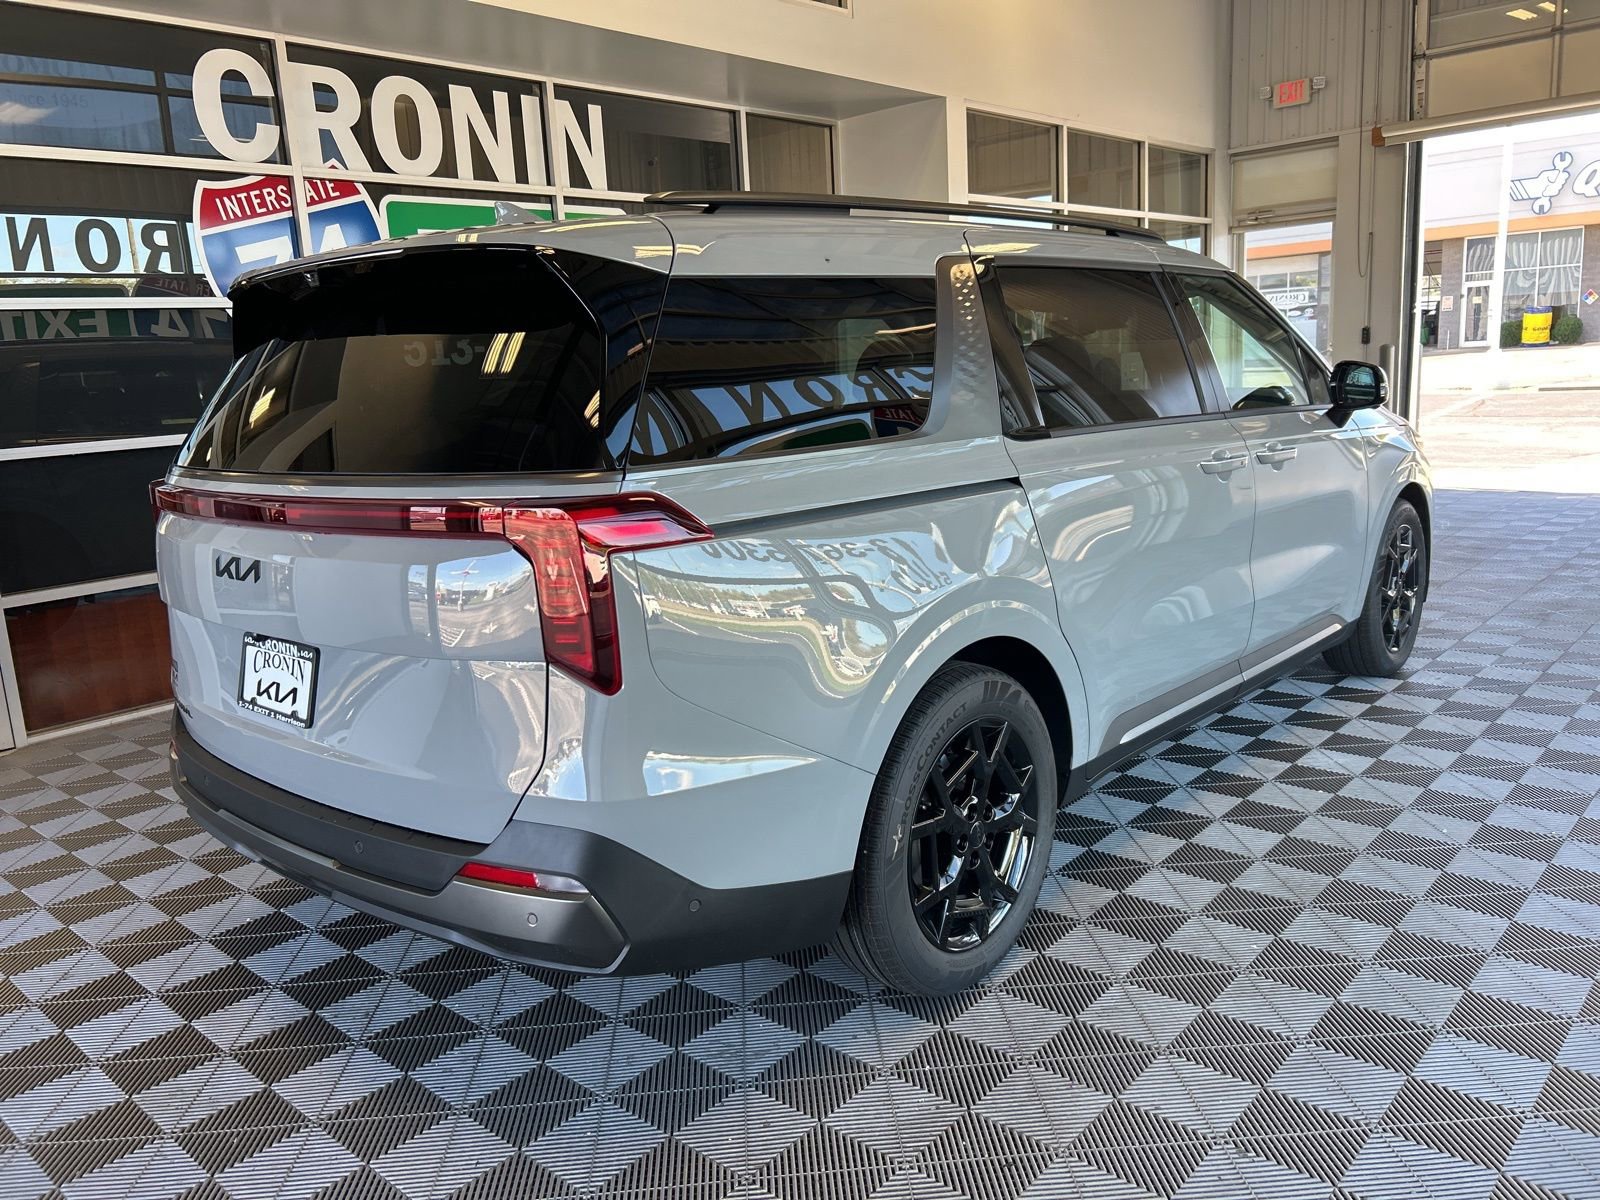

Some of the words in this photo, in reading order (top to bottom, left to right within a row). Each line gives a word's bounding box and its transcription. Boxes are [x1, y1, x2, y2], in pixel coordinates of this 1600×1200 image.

[1279, 79, 1305, 104] EXIT
[192, 48, 607, 190] CRONIN
[215, 179, 341, 221] INTERSATE
[215, 555, 261, 584] KIA
[259, 638, 298, 658] CRONIN
[253, 649, 306, 687] CRONIN
[256, 677, 298, 707] KIA
[253, 706, 270, 715] EXIT
[276, 713, 306, 728] Harrison
